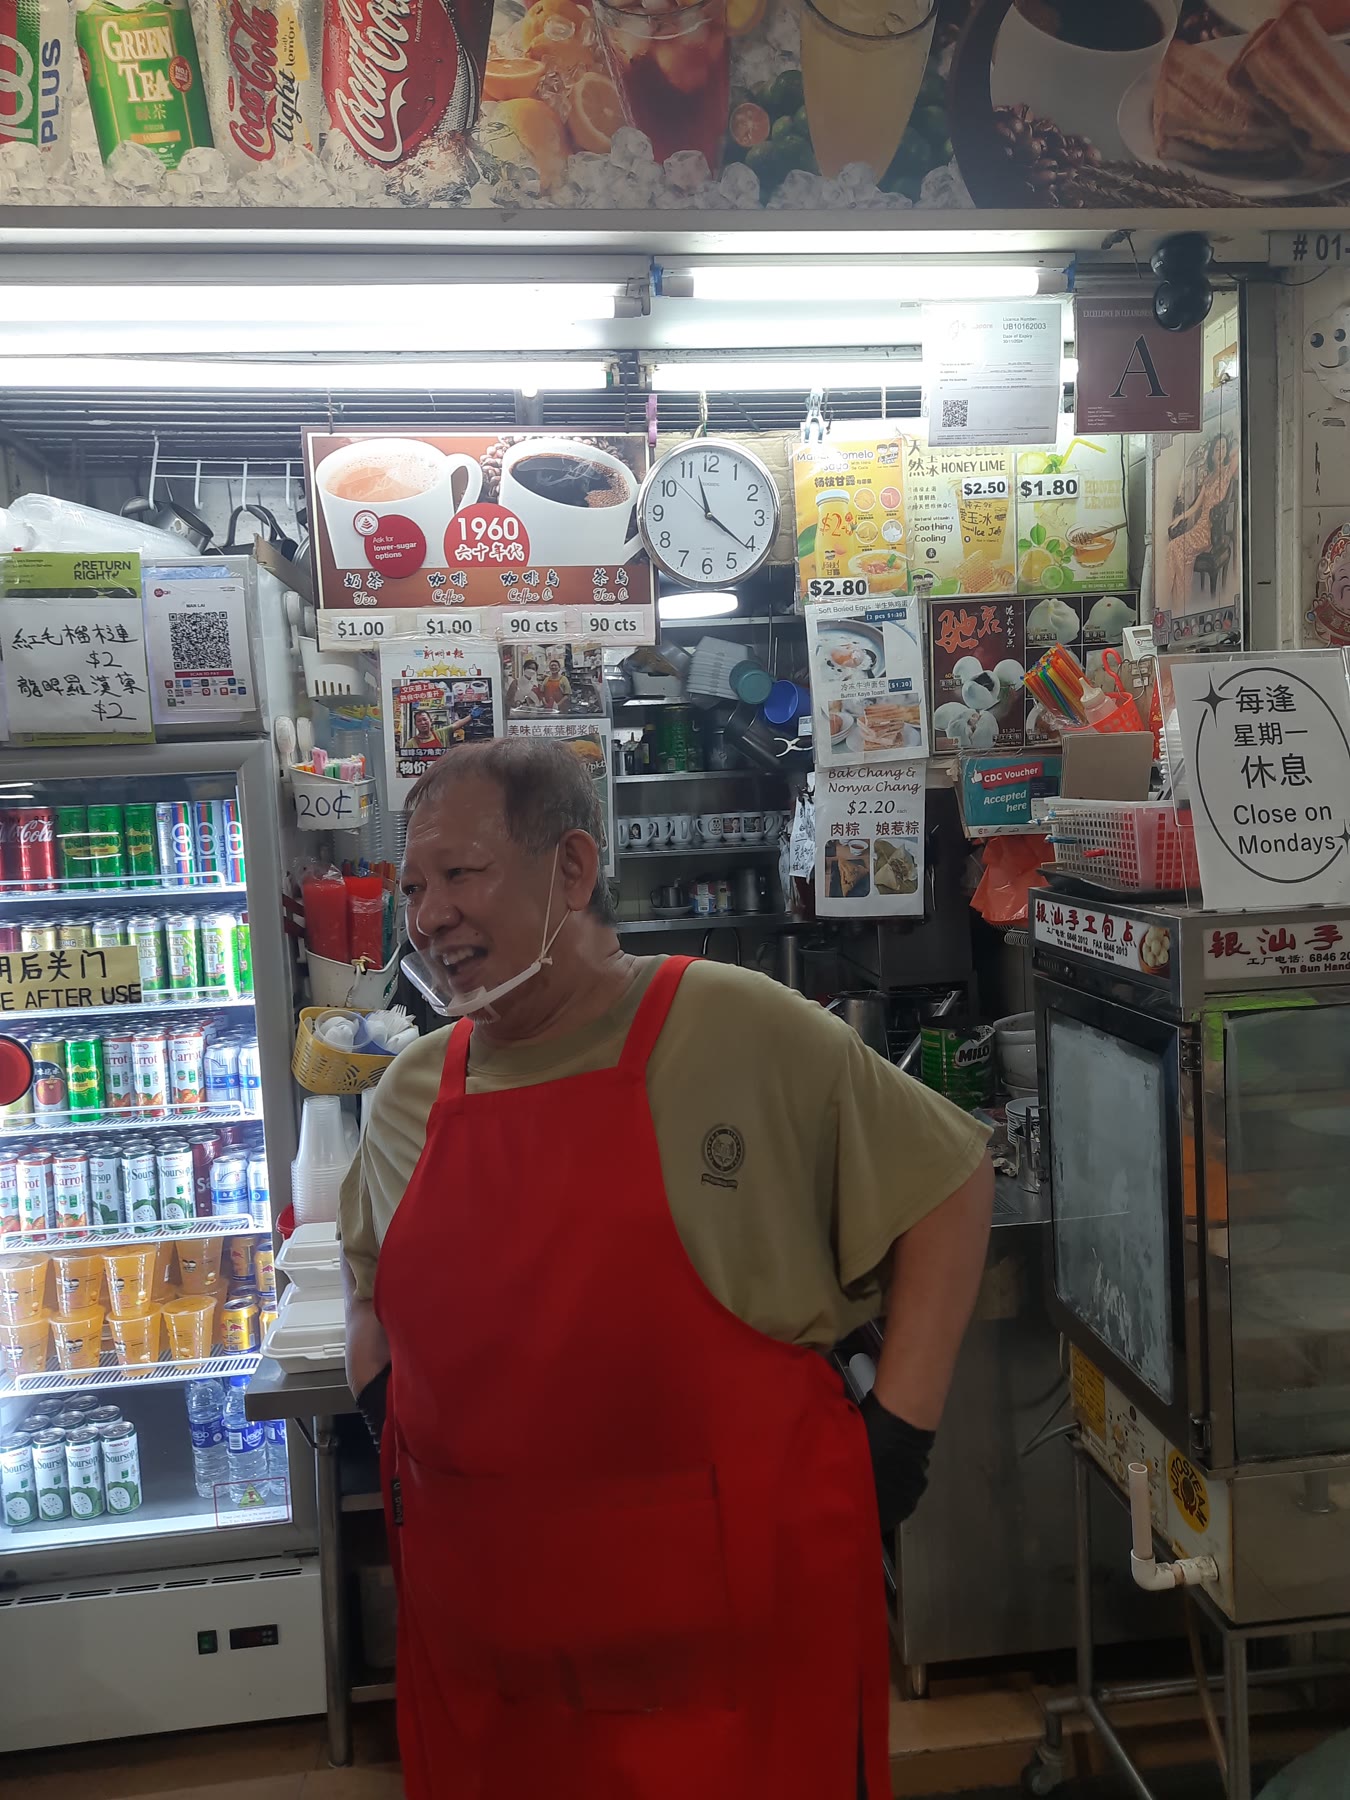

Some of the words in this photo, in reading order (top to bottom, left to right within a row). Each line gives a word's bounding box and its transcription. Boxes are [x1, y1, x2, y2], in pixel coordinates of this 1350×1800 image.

[101, 21, 173, 62] GREEN
[284, 20, 296, 67] lemon
[118, 61, 174, 102] TEA
[41, 38, 61, 144] PLUS
[272, 68, 302, 144] light
[1002, 322, 1047, 330] UB10162003
[1108, 333, 1171, 399] A
[681, 460, 693, 479] 11
[703, 455, 720, 473] 12
[732, 463, 738, 481] 1
[941, 460, 977, 473] HONEY
[979, 459, 1006, 472] LIME
[661, 480, 677, 498] 10
[746, 483, 759, 502] 2
[963, 481, 1006, 497] $2.50
[1020, 479, 1078, 499] $1.80
[652, 504, 664, 522] 9
[753, 509, 766, 527] 3
[457, 516, 520, 541] 1960
[914, 523, 953, 535] Soothing
[373, 536, 385, 544] Ask
[386, 535, 394, 543] for
[373, 541, 418, 552] lower-sugar
[659, 531, 671, 549] 8
[745, 534, 756, 553] 4
[914, 534, 947, 545] Cooling
[375, 551, 403, 561] options
[454, 541, 525, 562] 六十年代
[678, 550, 690, 568] 7
[81, 560, 132, 570] RETURN
[701, 558, 713, 575] 6
[725, 552, 738, 570] 5
[73, 570, 113, 580] RIGHT
[343, 570, 384, 591] 奶茶
[427, 570, 469, 588] 咖啡
[431, 588, 466, 606] Coffee
[507, 587, 540, 604] Coffee
[593, 586, 616, 602] Tea
[810, 579, 868, 598] $2.80
[352, 591, 378, 606] Tea
[818, 606, 832, 614] Soft
[833, 605, 854, 613] Boiled
[855, 604, 872, 612] Eggs
[874, 613, 886, 621] pcs
[337, 620, 385, 638] $1.00
[426, 618, 473, 636] $1.00
[510, 618, 531, 633] 90
[535, 619, 559, 632] cts
[589, 617, 610, 632] 90
[614, 618, 637, 631] cts
[86, 650, 122, 669] $2
[857, 690, 871, 698] Kaya
[871, 689, 885, 697] Toast
[1235, 684, 1297, 714] 每逢
[91, 700, 138, 722] $2
[1234, 722, 1308, 747] 星期一
[828, 767, 856, 779] Bak
[857, 767, 904, 781] Chang
[905, 766, 917, 778] &
[984, 773, 1003, 783] CDC
[1004, 767, 1039, 780] Voucher
[1240, 753, 1313, 789] 休息
[828, 782, 874, 796] Nonya
[875, 781, 921, 795] Chang
[983, 789, 1027, 806] Accepted
[847, 799, 896, 816] $2.20
[1006, 802, 1027, 813] here
[1233, 803, 1297, 825] Close
[1305, 805, 1332, 821] on
[19, 819, 54, 843] Cola
[830, 821, 860, 837] 肉粽
[875, 820, 920, 836] 娘惹粽
[1238, 832, 1336, 855] Mondays
[1066, 932, 1077, 942] 6846
[1077, 934, 1089, 946] 2012
[1092, 938, 1103, 950] FAX
[1103, 942, 1115, 953] 6846
[1116, 945, 1128, 957] 2013
[1072, 942, 1083, 952] Hand
[1083, 945, 1094, 956] Made
[1095, 950, 1104, 959] Pau
[1104, 952, 1115, 961] Dian
[1309, 953, 1336, 963] 6846
[1279, 965, 1297, 975] Yin
[25, 987, 93, 1009] AFTER
[101, 984, 141, 1005] USE
[959, 1045, 990, 1062] MILO
[68, 1455, 99, 1468] Soursop
[105, 1448, 137, 1464] Soursop
